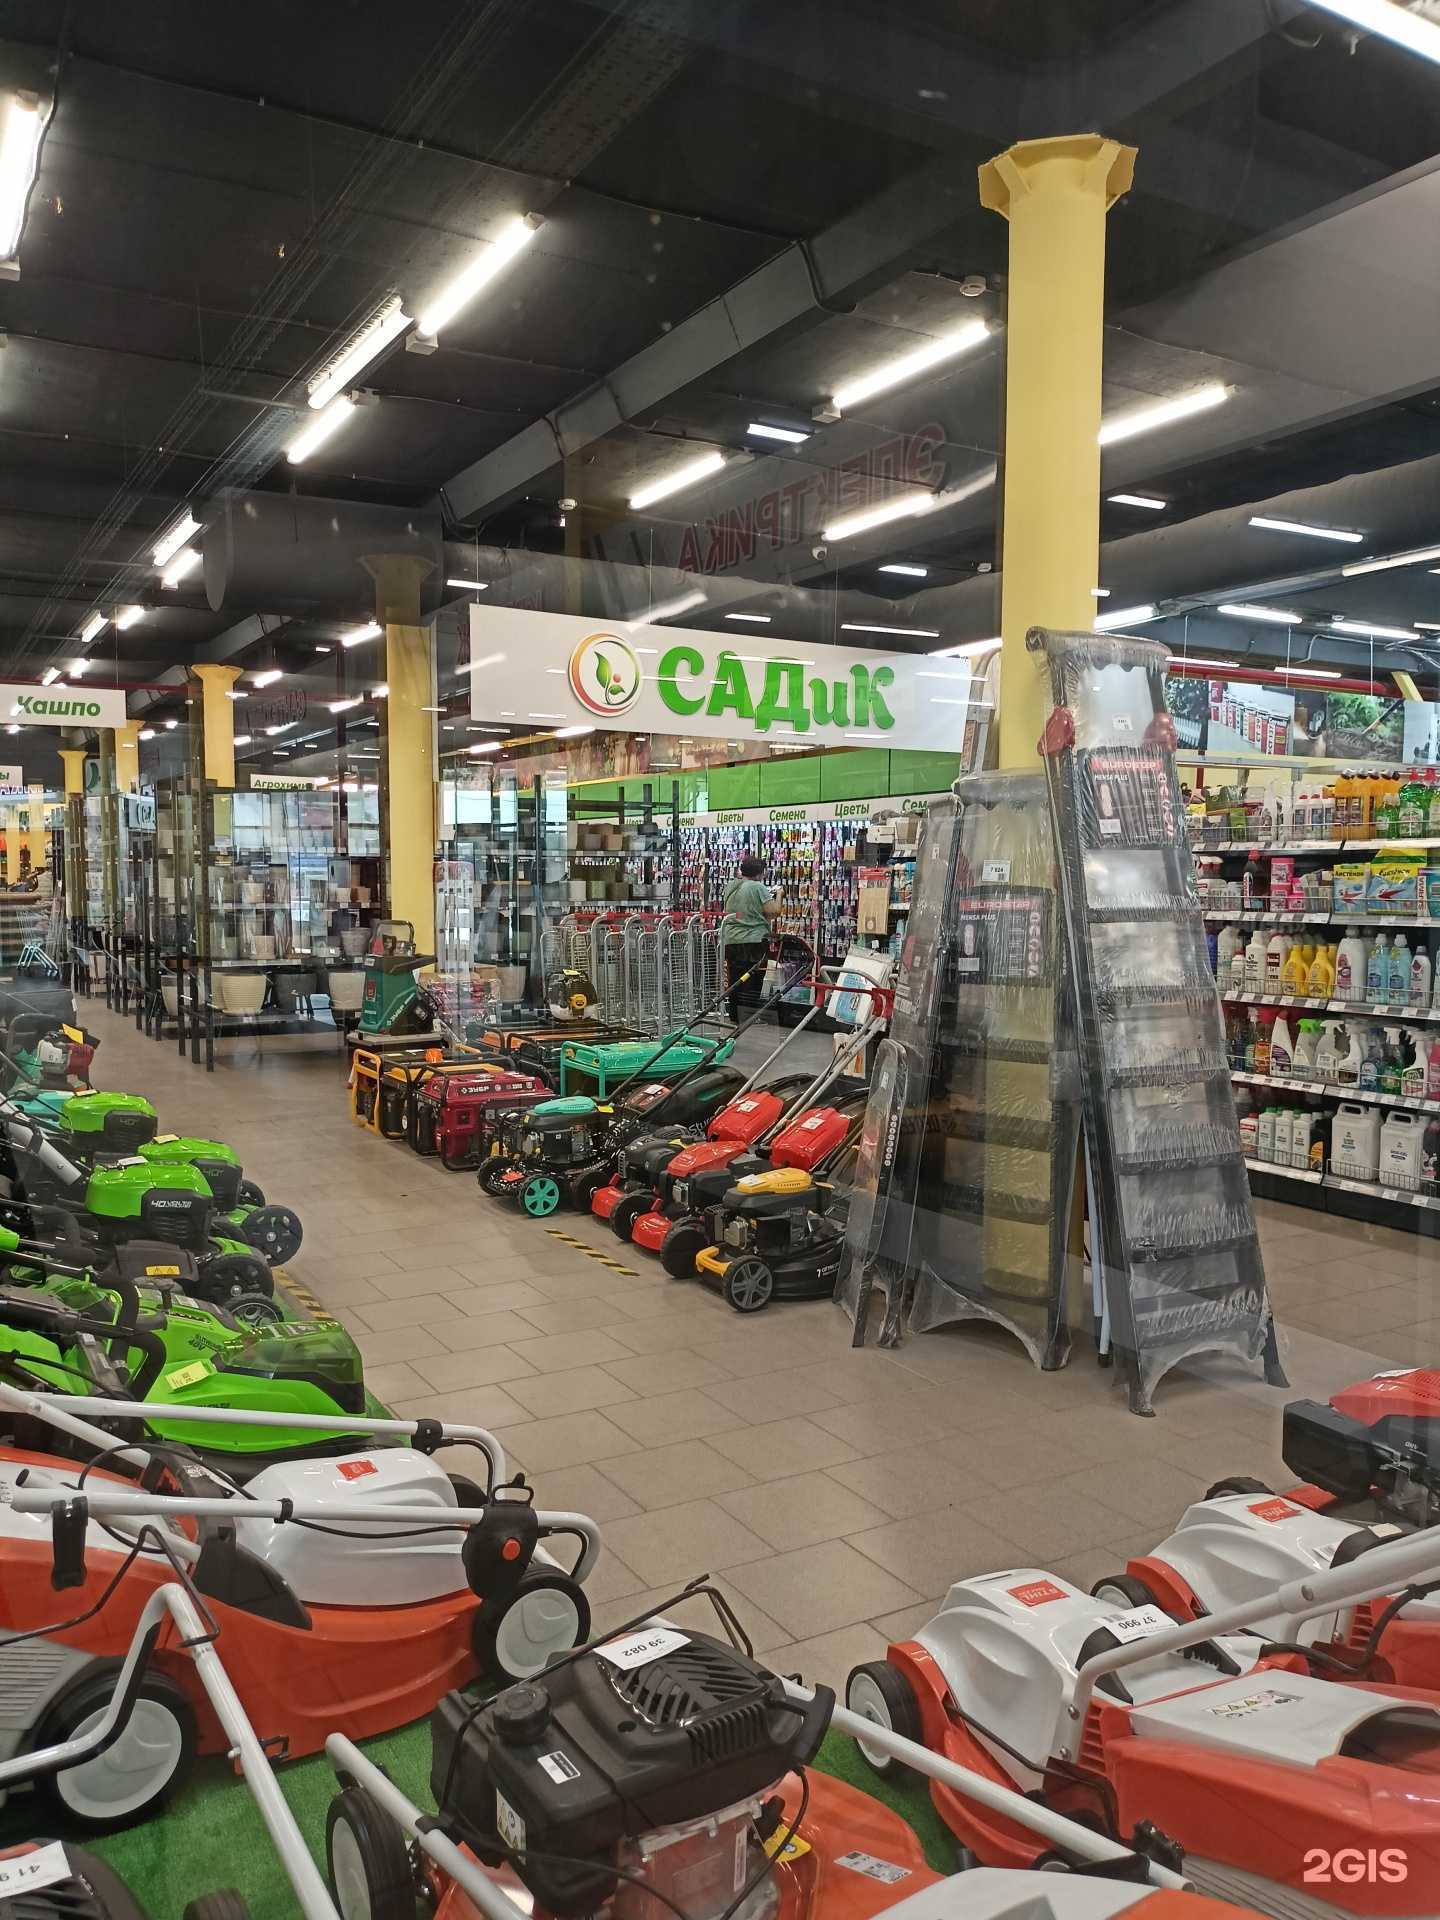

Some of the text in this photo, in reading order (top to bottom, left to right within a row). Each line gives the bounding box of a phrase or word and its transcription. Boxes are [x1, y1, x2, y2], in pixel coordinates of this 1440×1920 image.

[18, 695, 101, 717] Кашпо
[666, 816, 695, 827] Сена
[716, 812, 745, 825] Цветы
[769, 809, 807, 822] Семена
[834, 803, 870, 818] Цветы
[689, 1117, 714, 1137] Stur
[649, 1638, 666, 1648] 39
